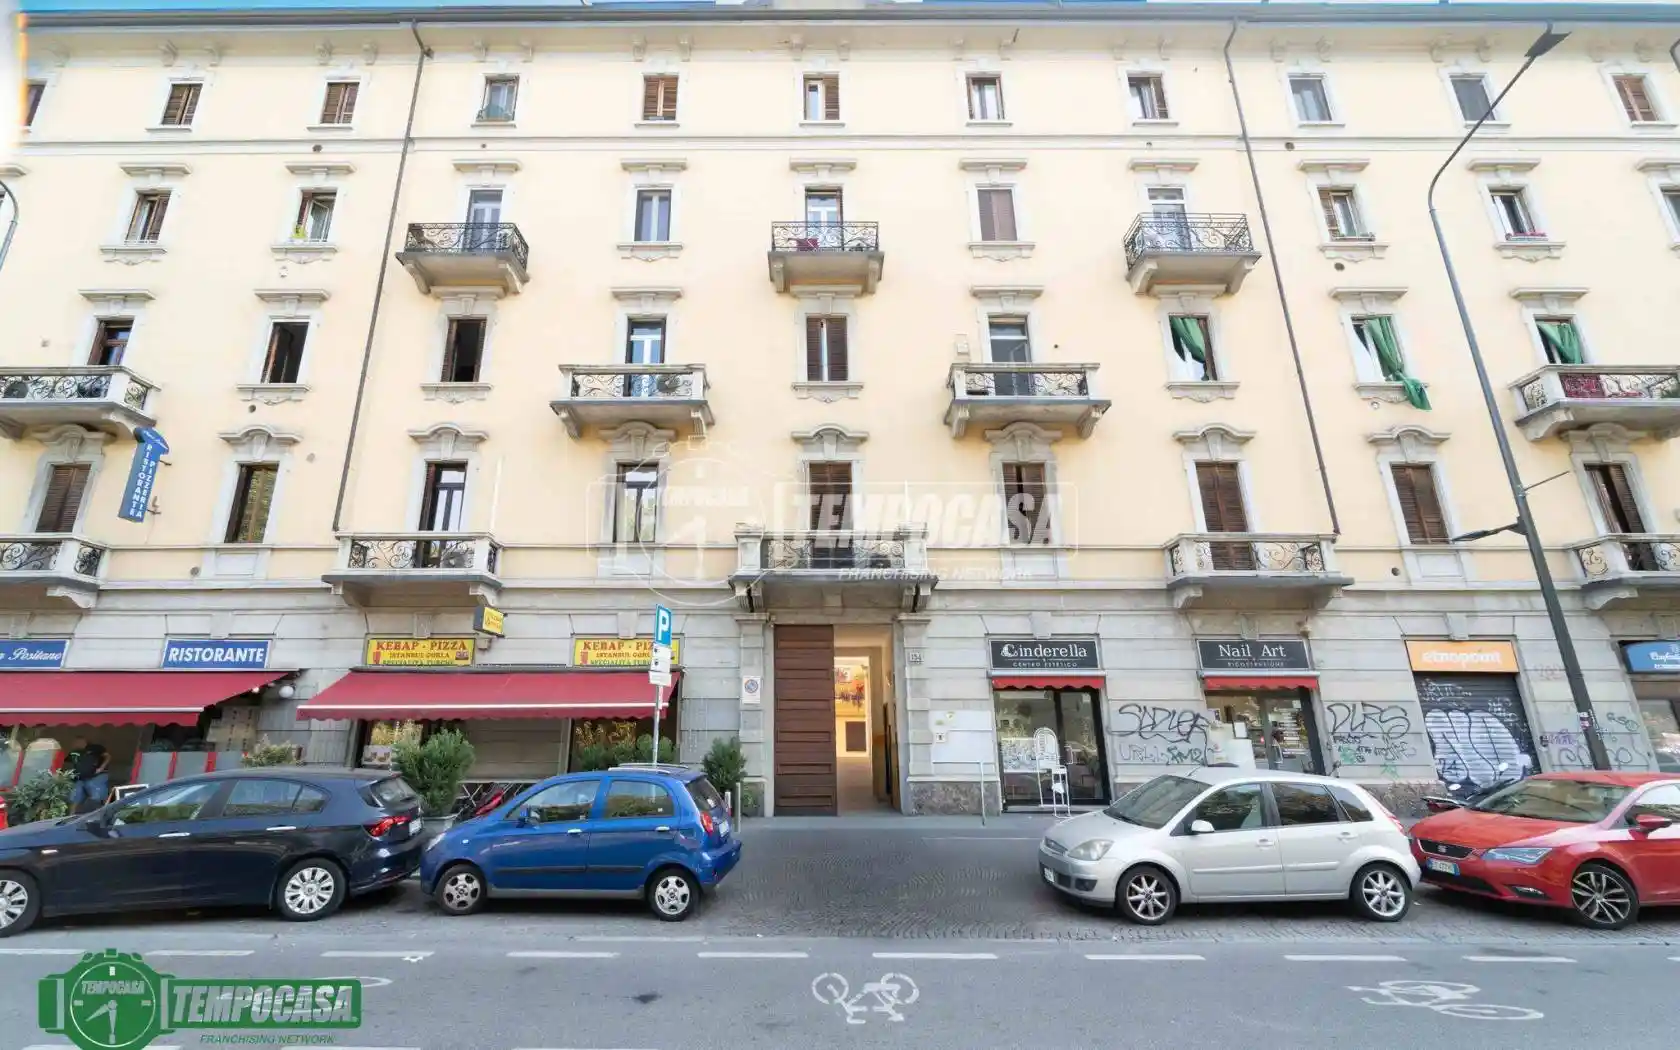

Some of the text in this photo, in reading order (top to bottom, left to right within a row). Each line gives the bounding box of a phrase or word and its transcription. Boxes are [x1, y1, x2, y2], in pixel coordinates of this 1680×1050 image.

[129, 443, 153, 517] RISTORANTE
[135, 460, 156, 518] PIZZERIA
[658, 608, 670, 642] P
[376, 640, 467, 651] KEBAP PIZZA
[583, 641, 625, 651] KEBAP
[1000, 643, 1088, 657] Cinderella
[1218, 643, 1287, 657] Nail Art
[168, 647, 265, 662] RISTORANTE
